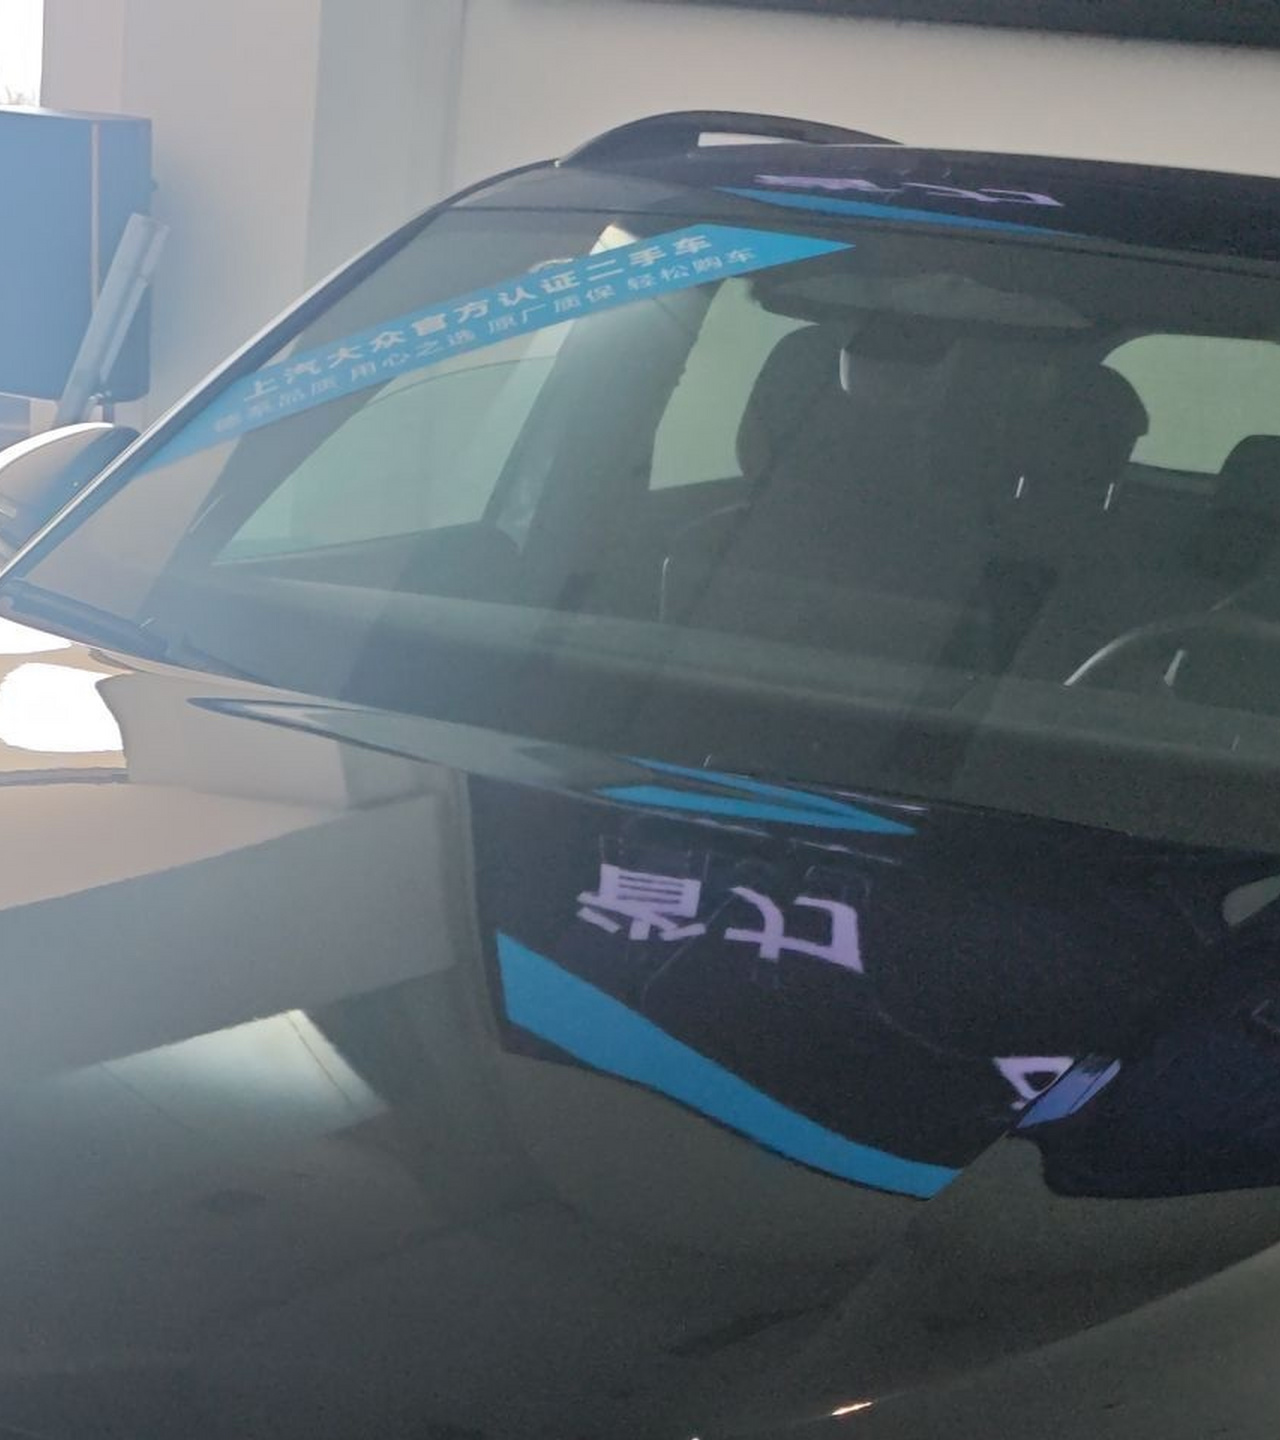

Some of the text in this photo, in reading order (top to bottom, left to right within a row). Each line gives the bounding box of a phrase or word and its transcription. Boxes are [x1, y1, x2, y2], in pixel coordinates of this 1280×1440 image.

[242, 235, 714, 402] 上汽大众官方认证二手车
[626, 247, 758, 292] 轻松购车
